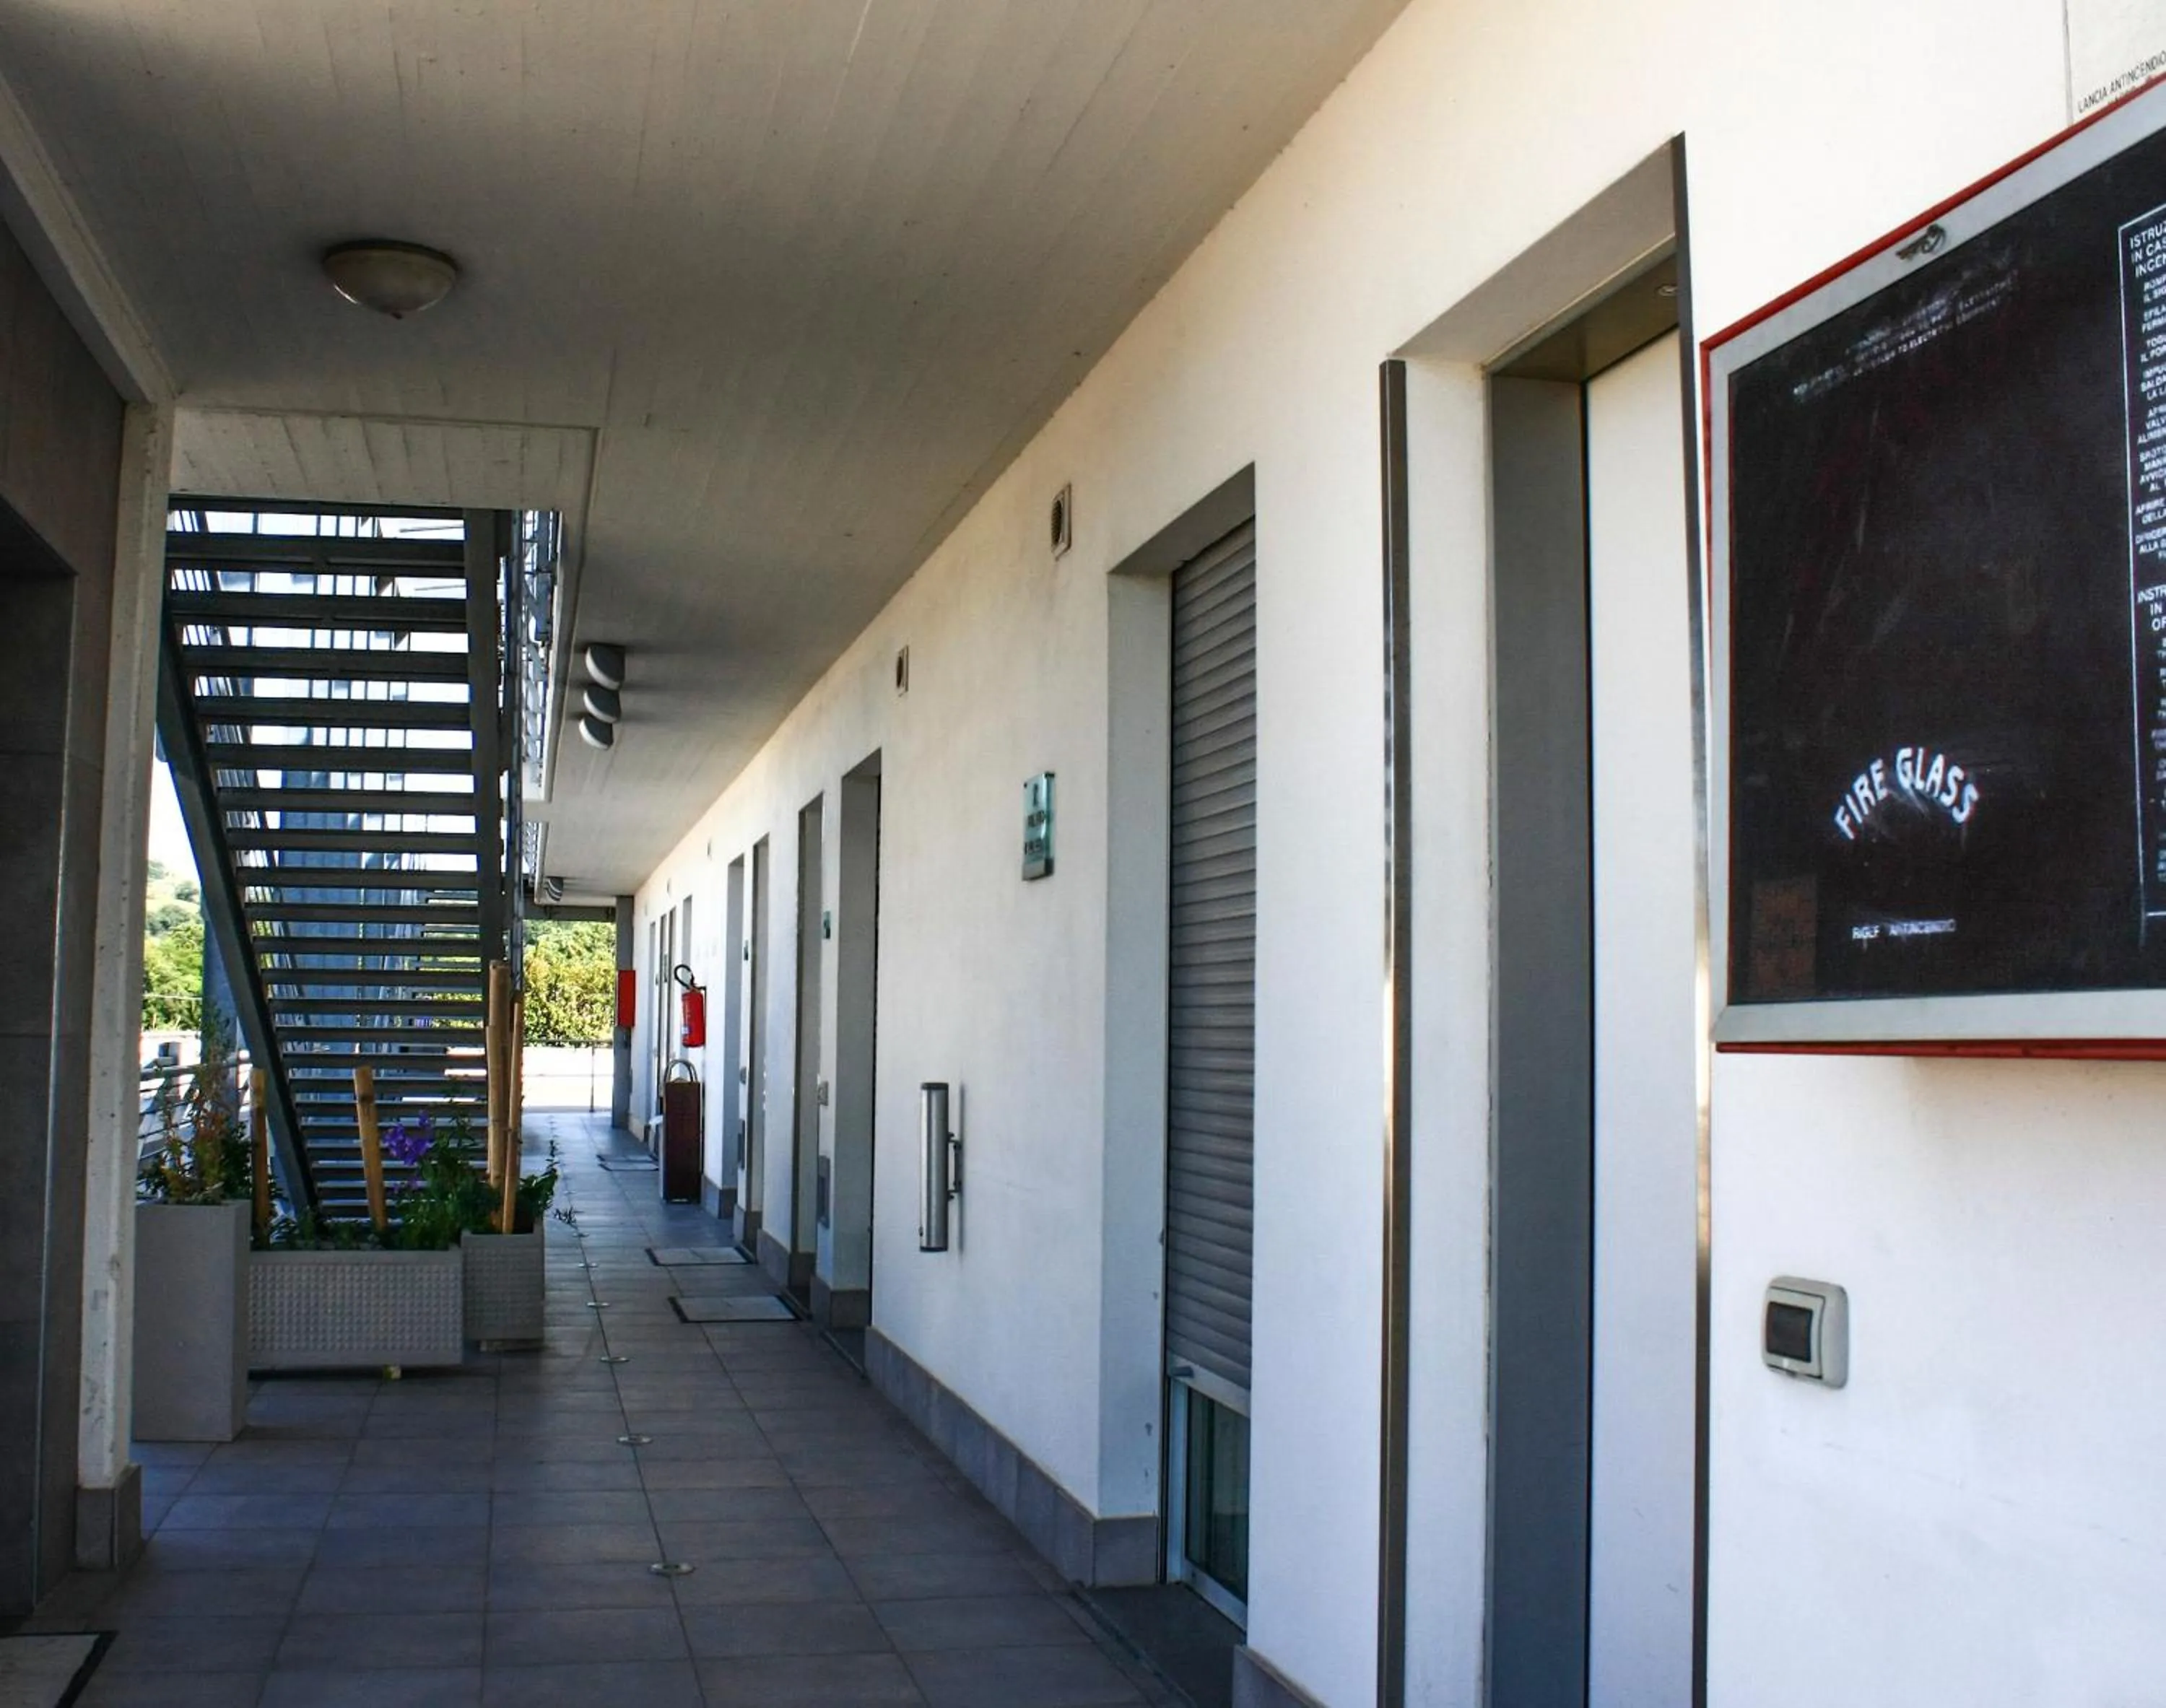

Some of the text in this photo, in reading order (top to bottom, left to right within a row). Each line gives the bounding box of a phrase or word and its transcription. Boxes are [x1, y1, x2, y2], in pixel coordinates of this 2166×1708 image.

[2077, 86, 2108, 113] LANCIA
[2131, 248, 2143, 265] IN
[2149, 601, 2162, 616] IN
[1834, 746, 1980, 840] FIRE GLASS
